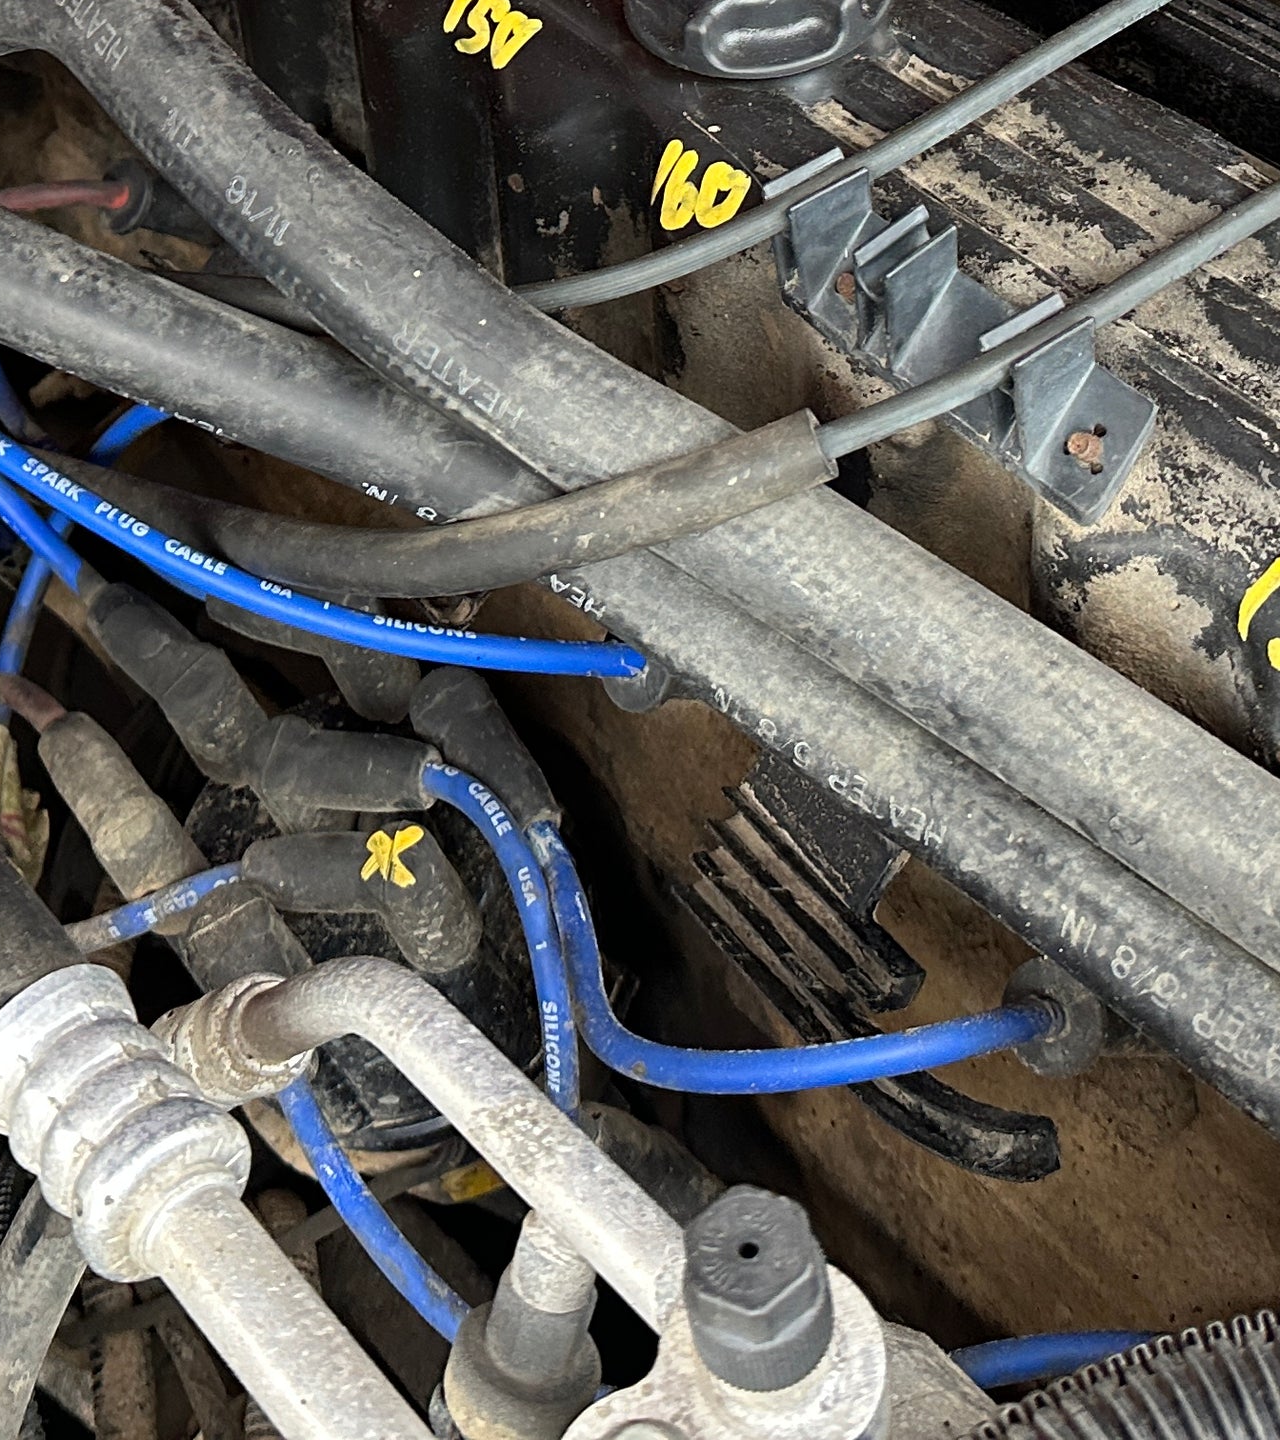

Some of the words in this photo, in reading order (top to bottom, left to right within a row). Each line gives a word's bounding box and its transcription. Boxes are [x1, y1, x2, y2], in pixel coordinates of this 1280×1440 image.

[651, 139, 752, 231] 160
[21, 457, 87, 503] SPARK
[94, 500, 151, 537] PLUG
[163, 538, 229, 577] CABLE
[259, 579, 293, 600] USA
[467, 782, 513, 837] CABLE
[517, 866, 537, 908] USA
